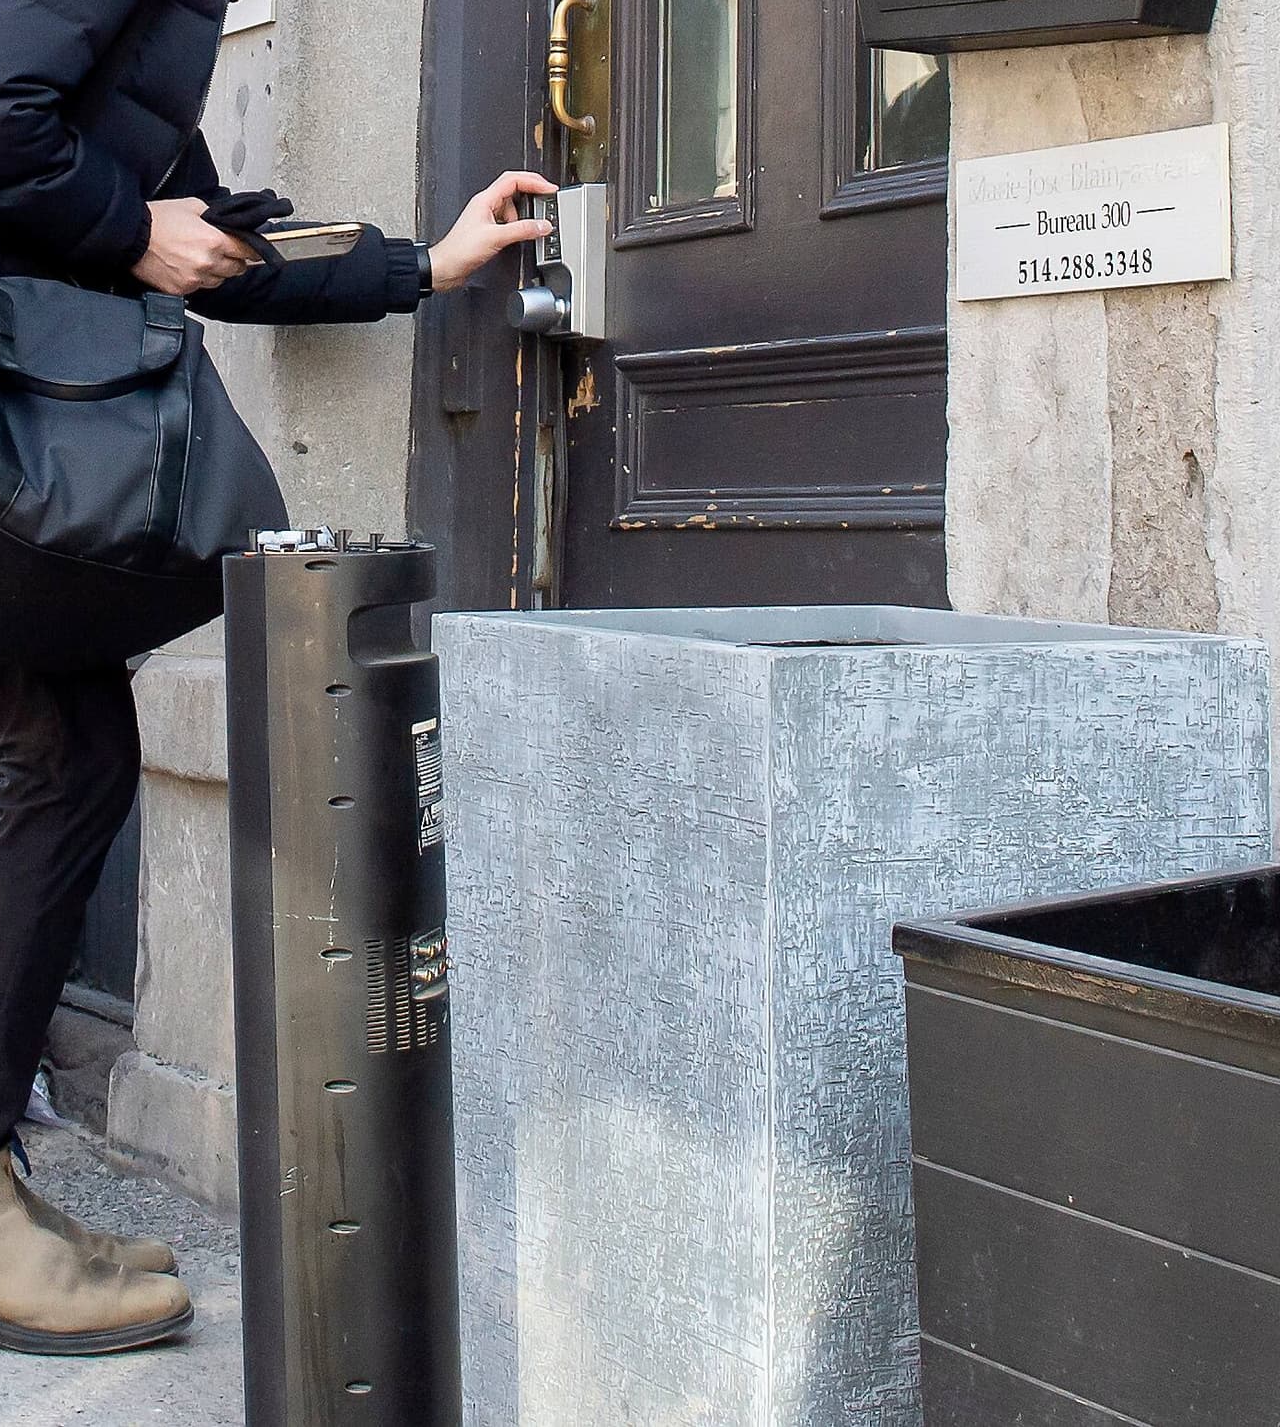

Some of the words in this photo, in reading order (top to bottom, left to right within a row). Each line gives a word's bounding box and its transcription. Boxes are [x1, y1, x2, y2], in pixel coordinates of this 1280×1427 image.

[1036, 209, 1096, 236] Bureau
[1101, 200, 1131, 229] 300
[1018, 247, 1153, 285] 514.288.3348
